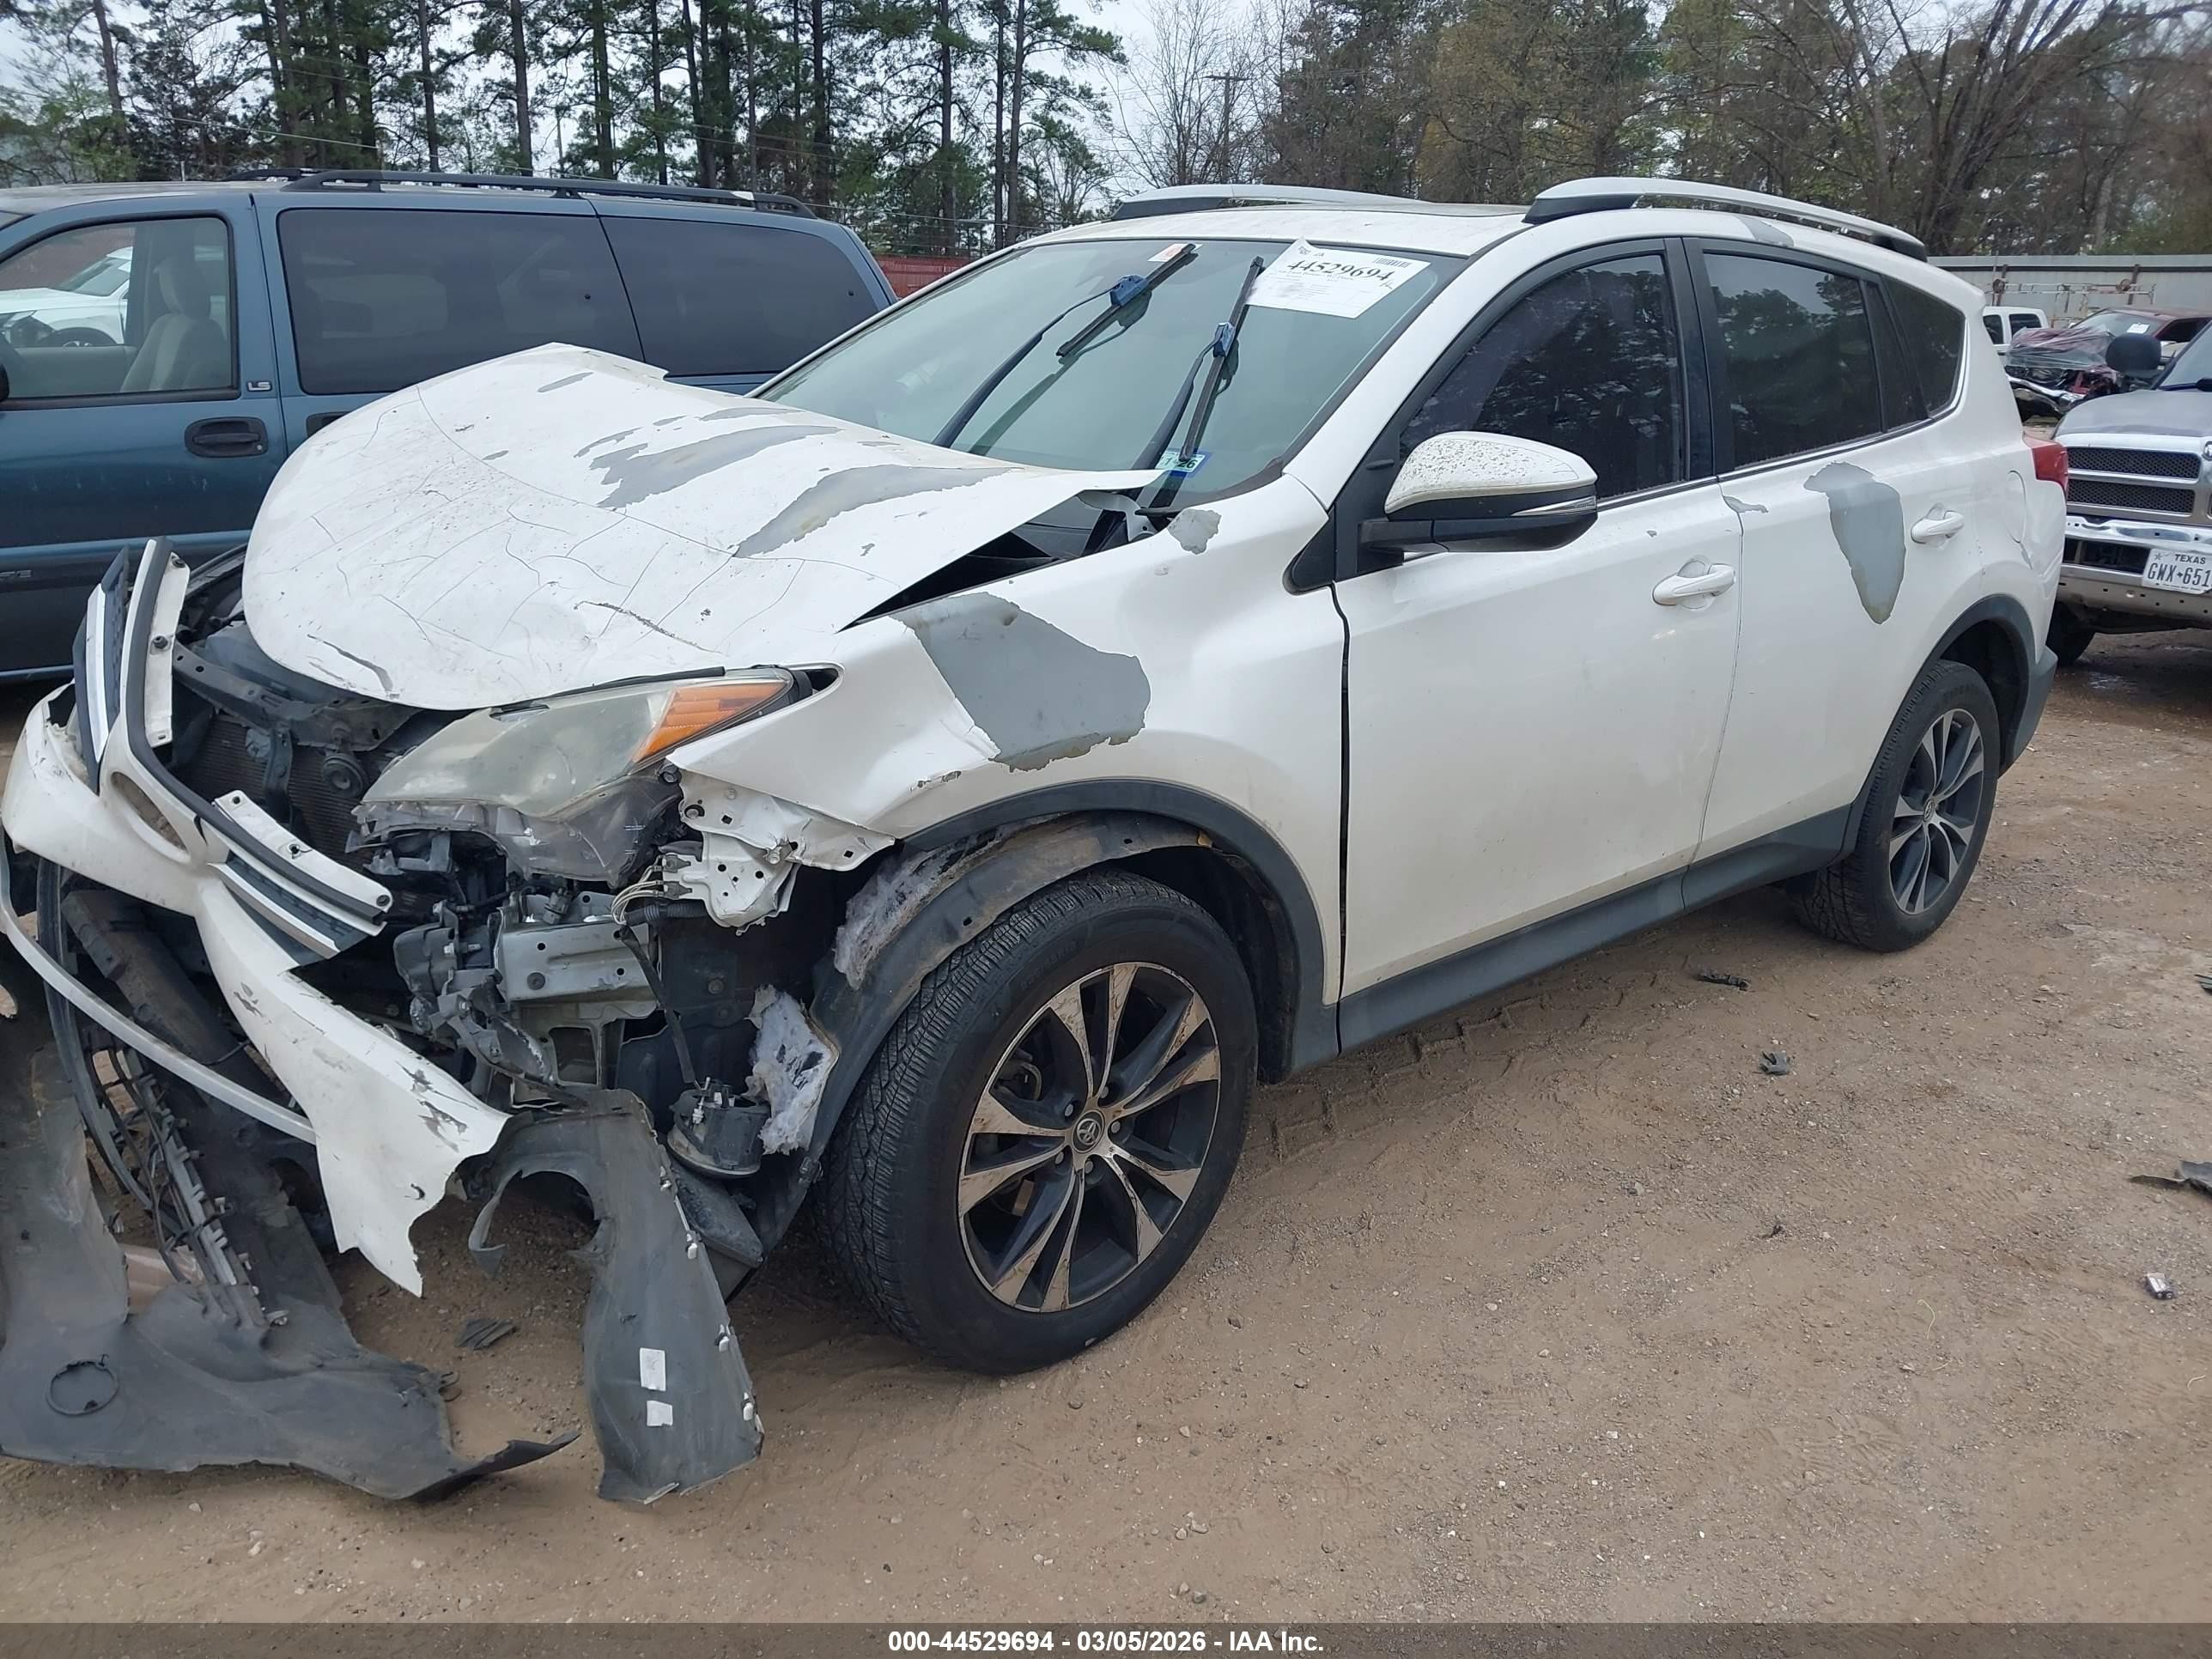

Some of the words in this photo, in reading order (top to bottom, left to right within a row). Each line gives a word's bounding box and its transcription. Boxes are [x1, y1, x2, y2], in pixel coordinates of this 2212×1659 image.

[1287, 259, 1395, 281] 44529694
[247, 380, 272, 392] LS
[2174, 554, 2206, 565] TEXAS
